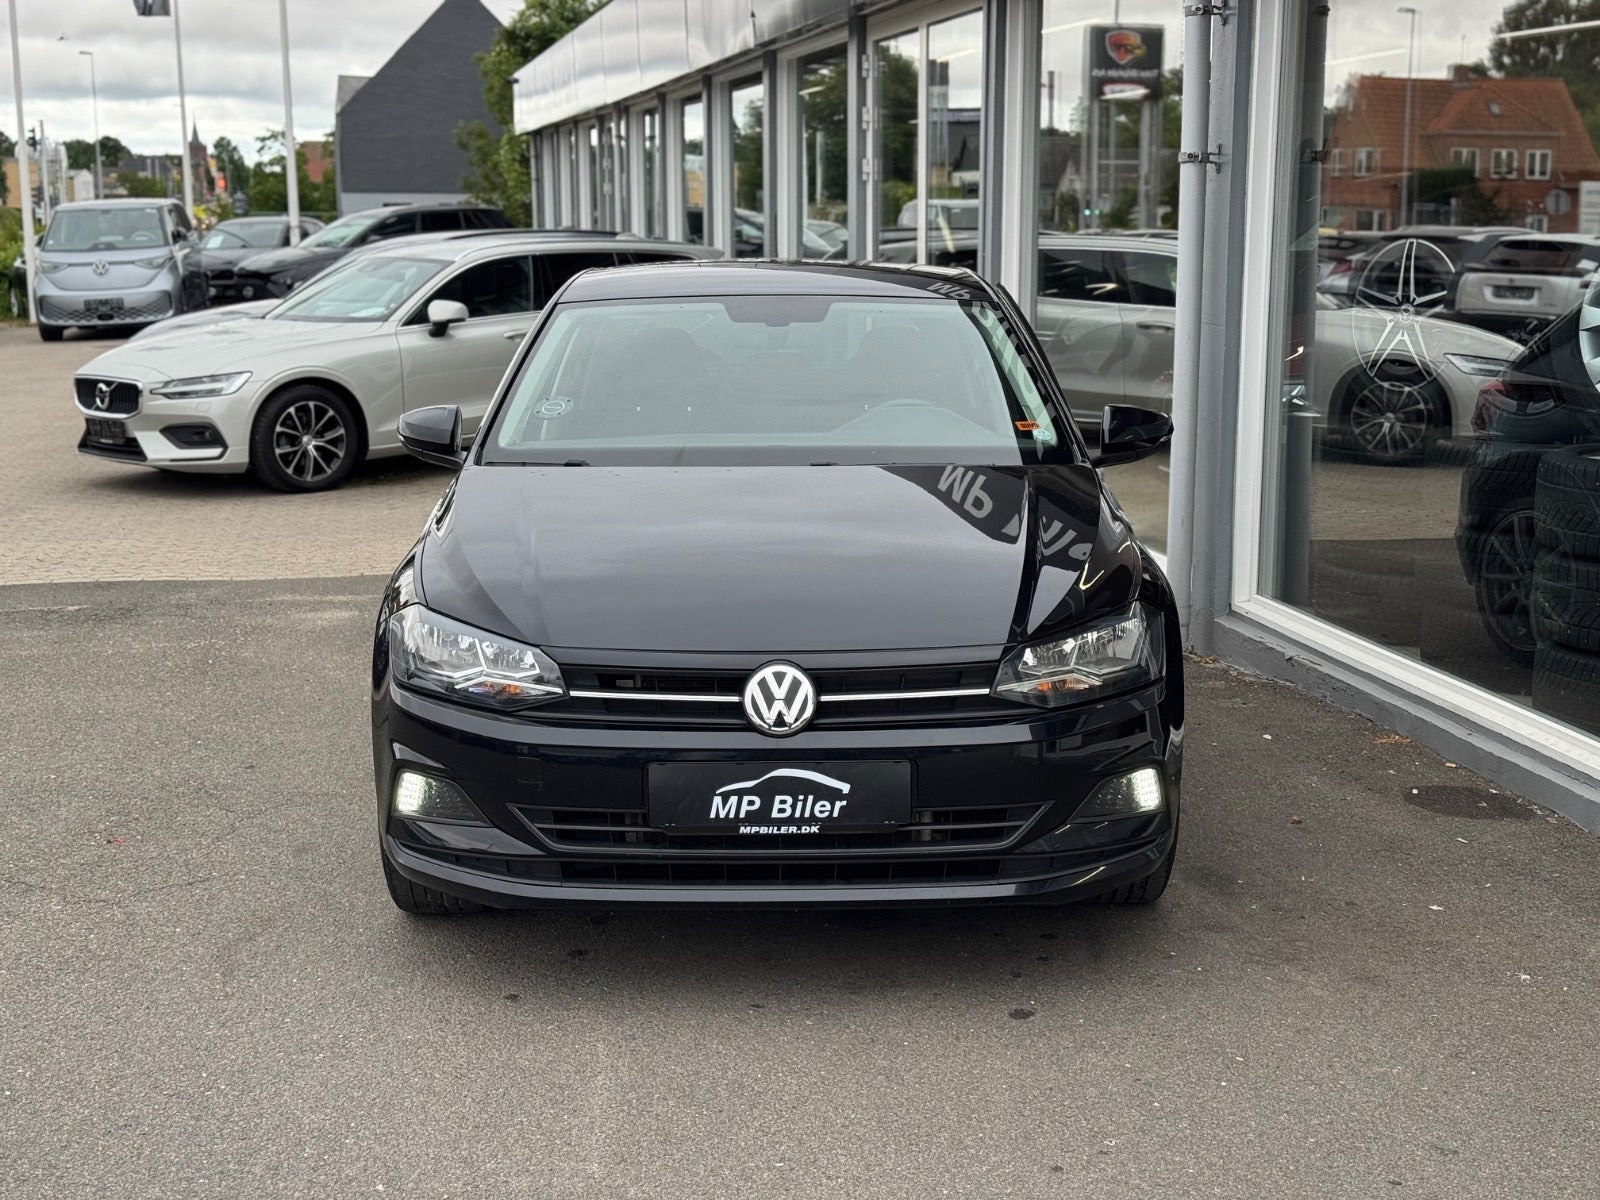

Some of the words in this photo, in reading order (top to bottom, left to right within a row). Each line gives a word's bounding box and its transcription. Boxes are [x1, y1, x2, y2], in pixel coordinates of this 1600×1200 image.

[710, 795, 761, 819] MP
[771, 794, 846, 819] Biler
[739, 825, 820, 834] MPBILER.DK
